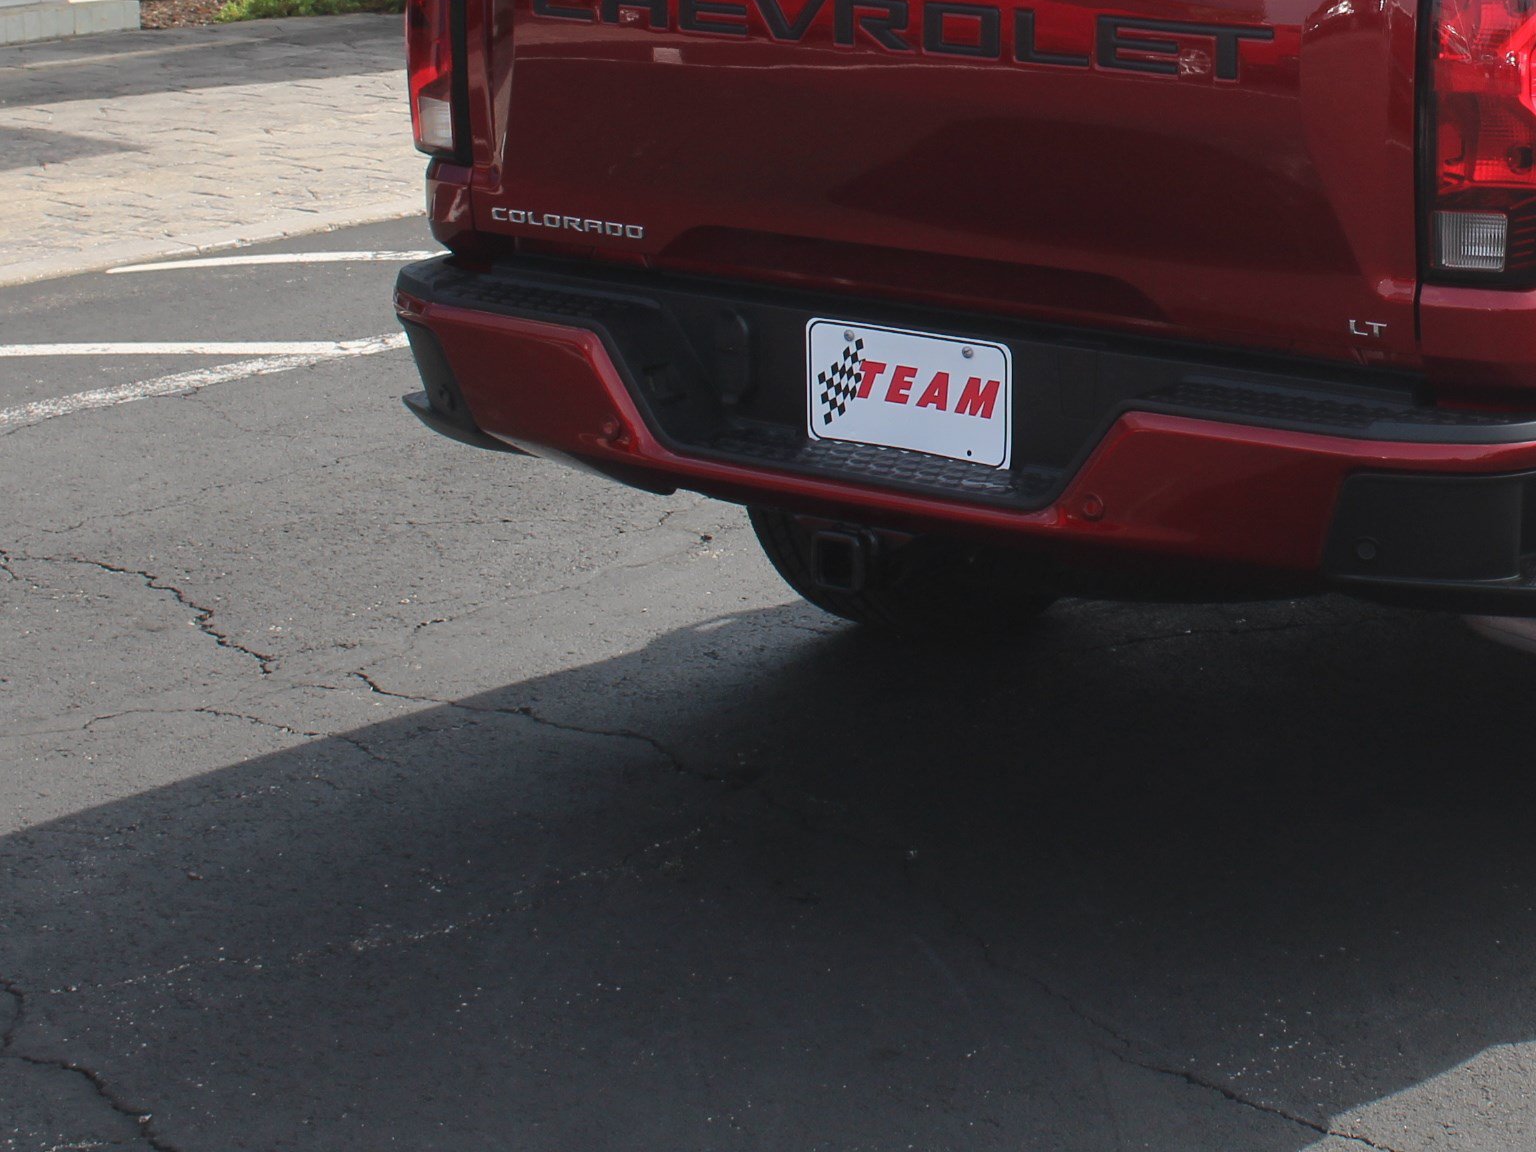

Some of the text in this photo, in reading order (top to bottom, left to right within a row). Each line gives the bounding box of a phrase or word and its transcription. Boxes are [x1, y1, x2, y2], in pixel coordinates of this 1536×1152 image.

[491, 206, 644, 239] COLORADO
[1348, 319, 1388, 338] LT
[856, 359, 1001, 420] TEAM
